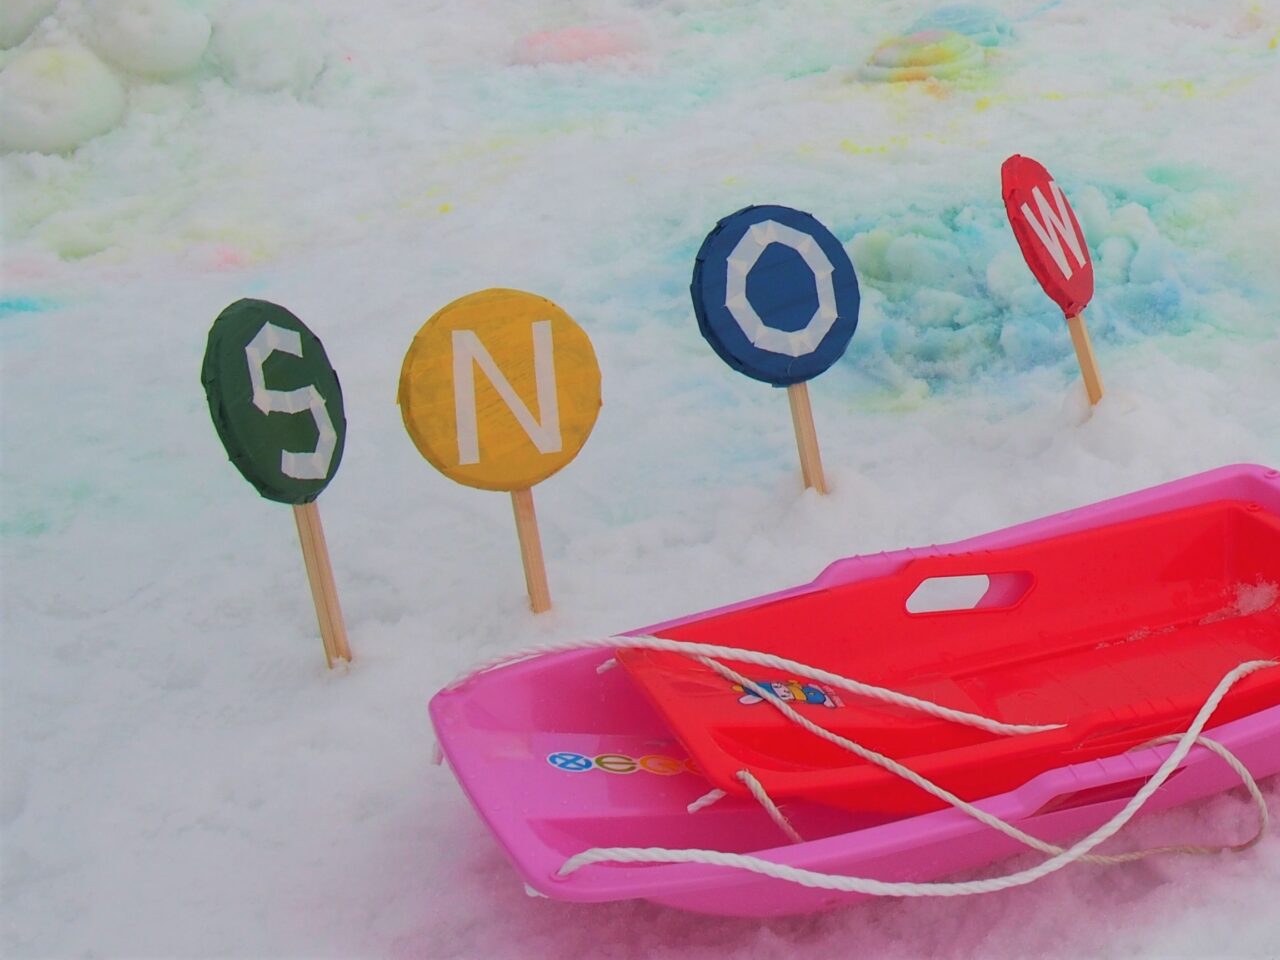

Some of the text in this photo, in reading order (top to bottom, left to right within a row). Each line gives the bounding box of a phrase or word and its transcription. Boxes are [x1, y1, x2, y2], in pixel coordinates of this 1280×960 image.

[723, 219, 838, 357] O
[1021, 180, 1087, 280] W
[245, 321, 337, 480] S
[451, 320, 563, 465] N
